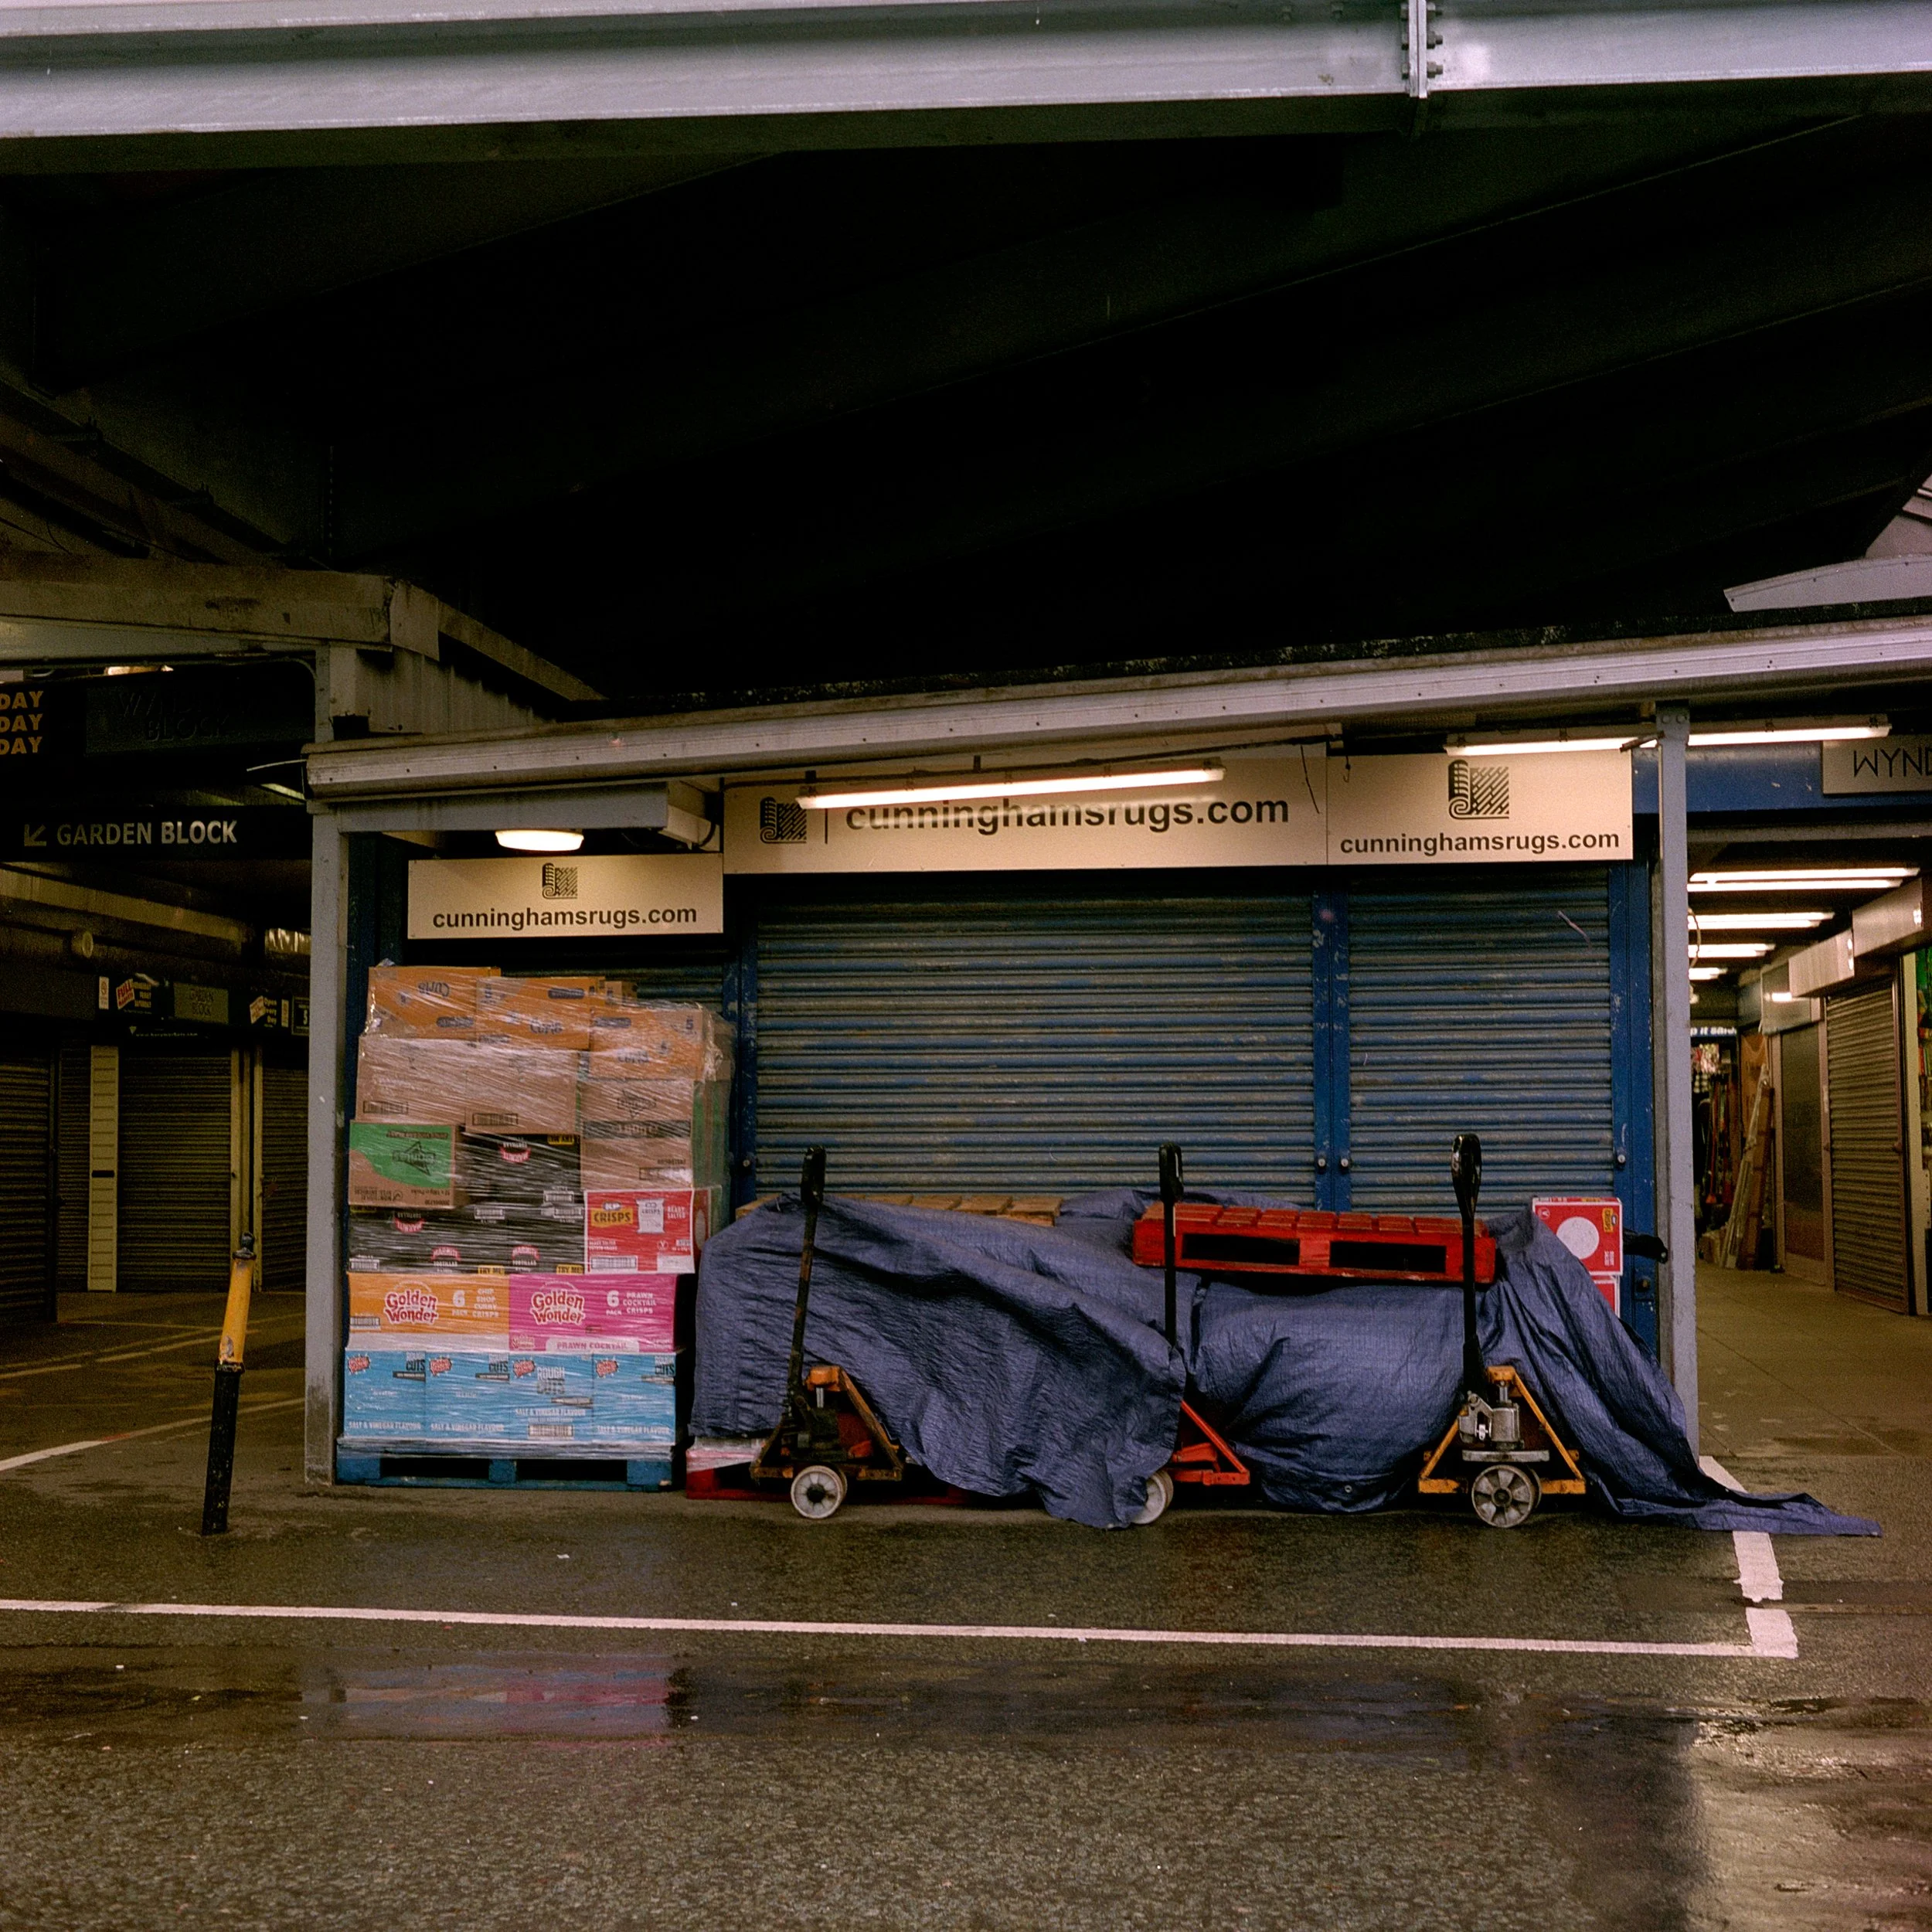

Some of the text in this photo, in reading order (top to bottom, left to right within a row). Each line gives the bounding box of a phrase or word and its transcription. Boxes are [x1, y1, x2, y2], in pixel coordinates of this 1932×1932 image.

[846, 798, 1288, 835] cunninghamsrugs.com
[56, 822, 152, 845] GARDEN
[161, 819, 237, 844] BLOCK
[1340, 832, 1620, 855] cunninghamsrugs.com
[432, 906, 697, 931] cunninghamsrugs.com
[594, 1211, 631, 1223] CRISPS
[386, 1290, 437, 1311] Golden
[453, 1290, 466, 1308] 6
[532, 1291, 584, 1311] Golden
[606, 1290, 620, 1308] 6
[384, 1308, 439, 1325] Wonder
[531, 1308, 585, 1325] Wonder
[556, 1341, 628, 1350] PRAWN COCKTAIL
[406, 1359, 426, 1372] CUTS
[488, 1360, 509, 1372] CUTS
[536, 1366, 565, 1381] ROUGH
[655, 1363, 675, 1376] CUTS
